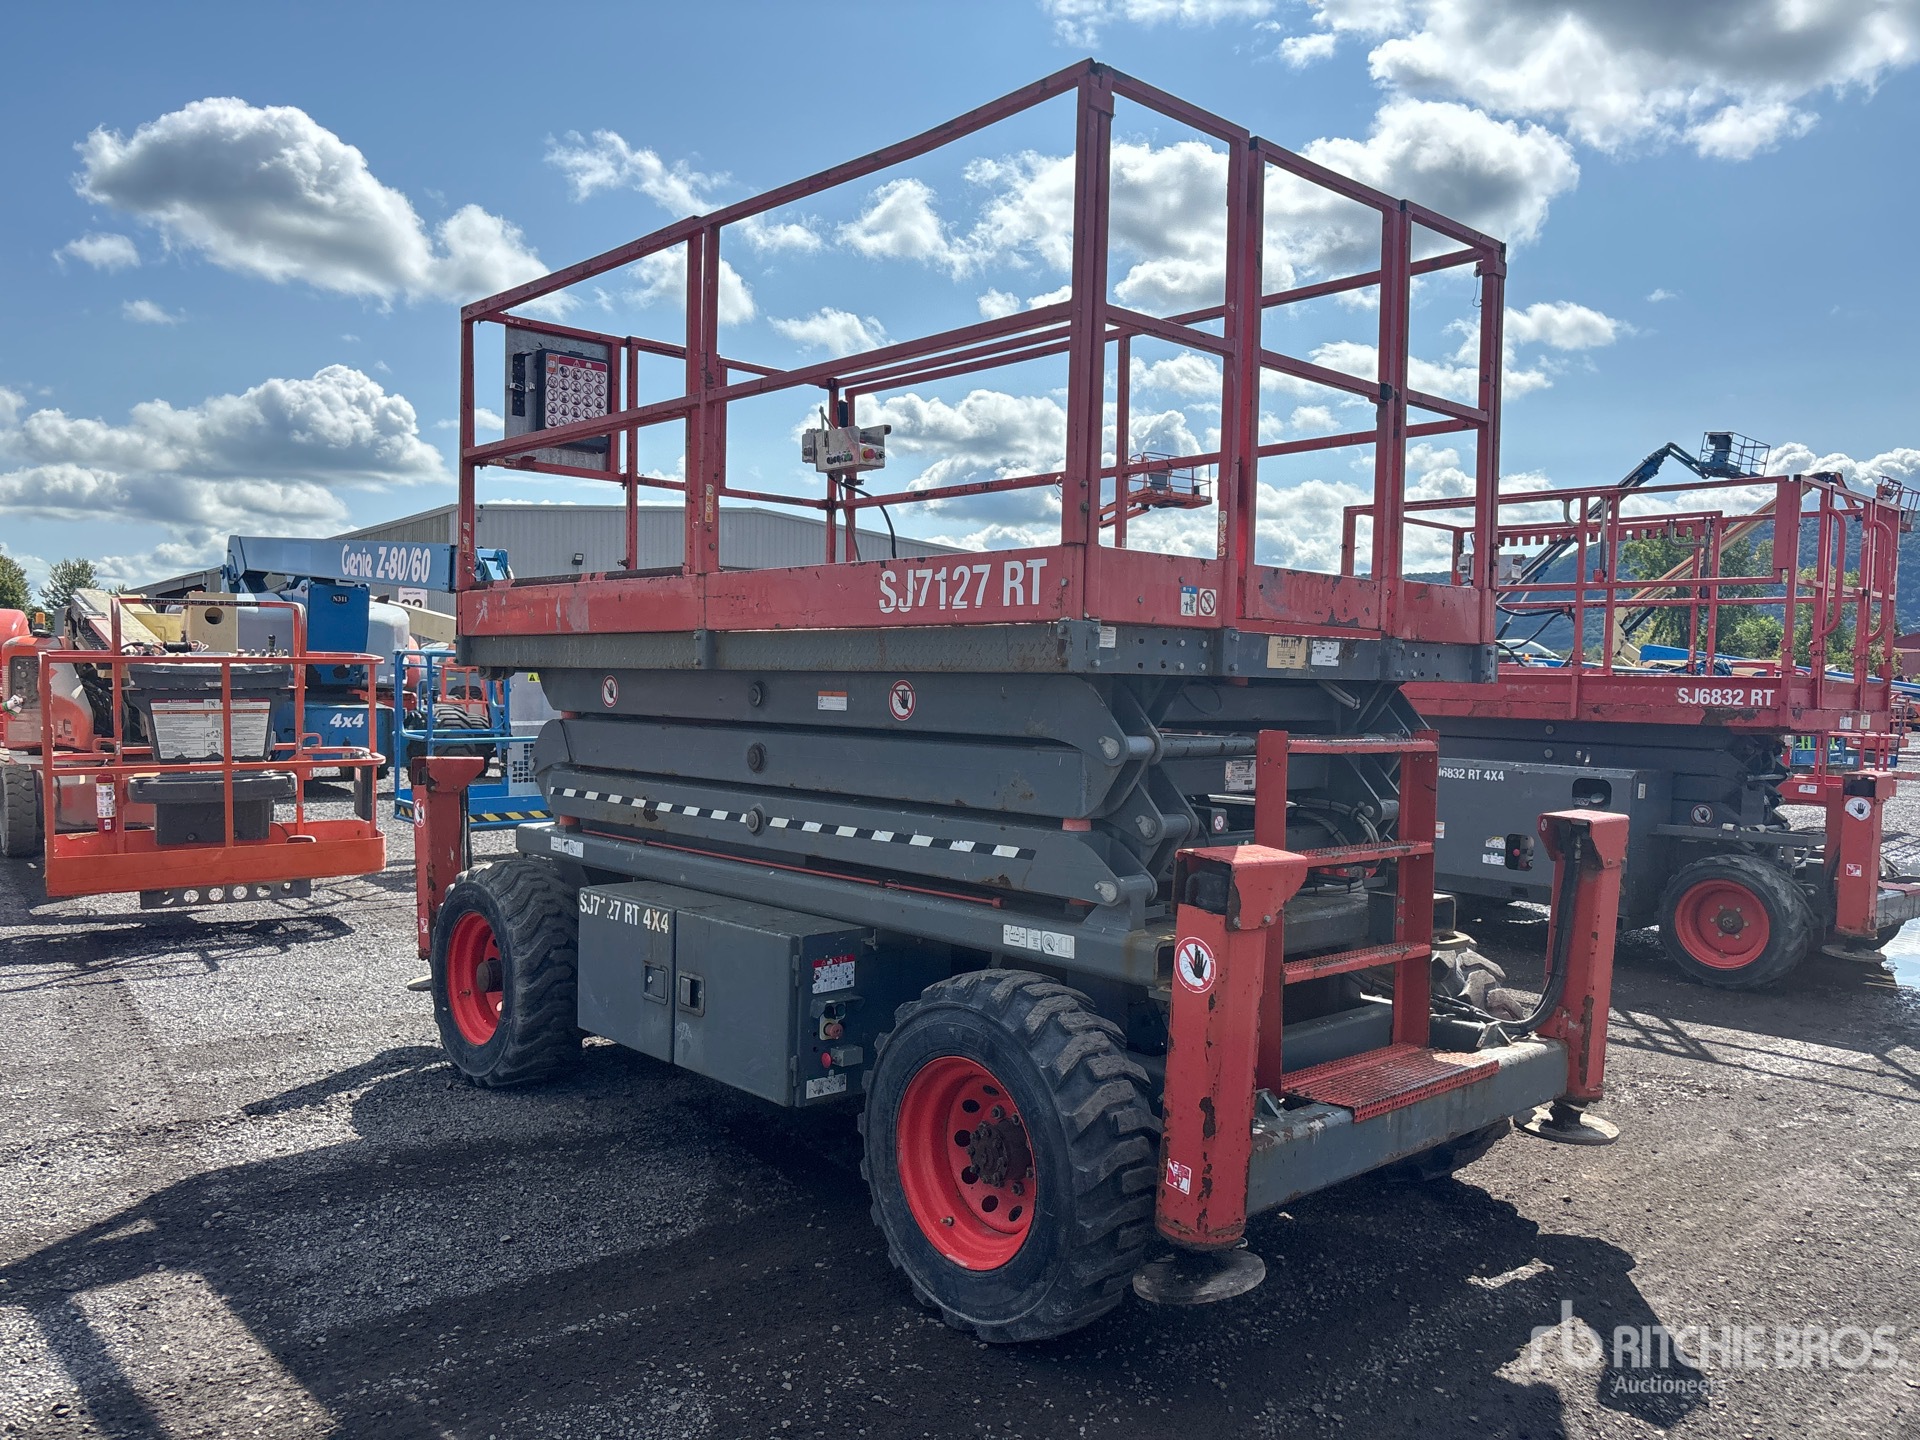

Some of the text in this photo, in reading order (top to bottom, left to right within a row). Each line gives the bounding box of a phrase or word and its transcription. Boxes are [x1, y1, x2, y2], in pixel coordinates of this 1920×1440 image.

[341, 543, 431, 584] Genie Z-80/60
[878, 557, 1048, 614] SJ7127 RT
[1677, 687, 1745, 706] SJ6832
[1750, 689, 1775, 706] RT
[329, 713, 364, 728] 4x4
[1467, 769, 1482, 780] RT
[1483, 770, 1505, 781] 4X4
[624, 902, 640, 926] RT
[642, 908, 669, 934] 4X4
